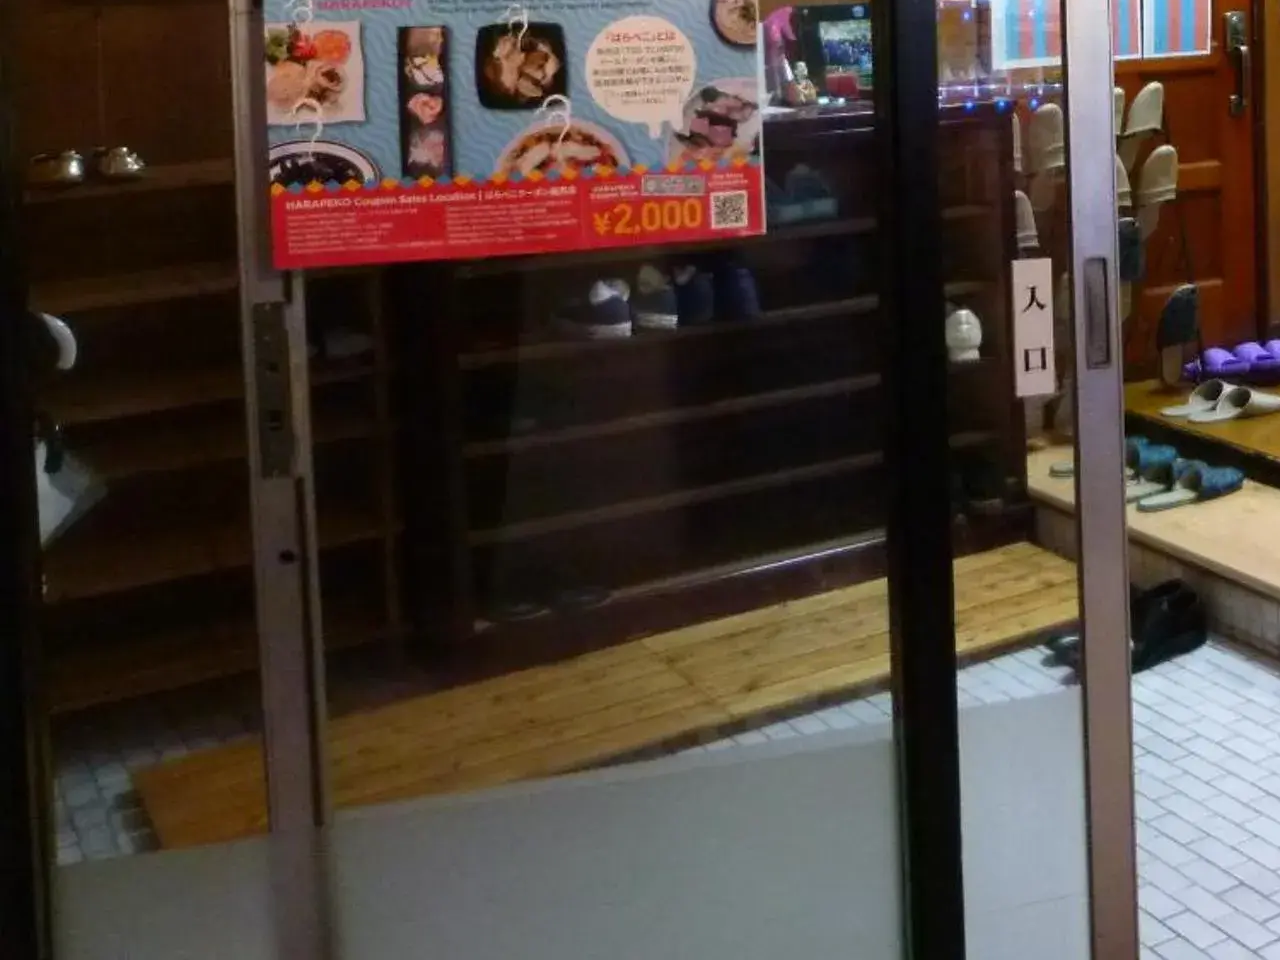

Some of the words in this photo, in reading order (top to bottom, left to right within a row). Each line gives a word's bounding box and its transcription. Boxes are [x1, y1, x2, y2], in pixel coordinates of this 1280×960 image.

[285, 196, 351, 210] HARAPEKO
[354, 195, 396, 208] Coupon
[398, 193, 427, 205] Sales
[592, 197, 703, 236] ¥2,000
[1022, 284, 1047, 373] 入口
